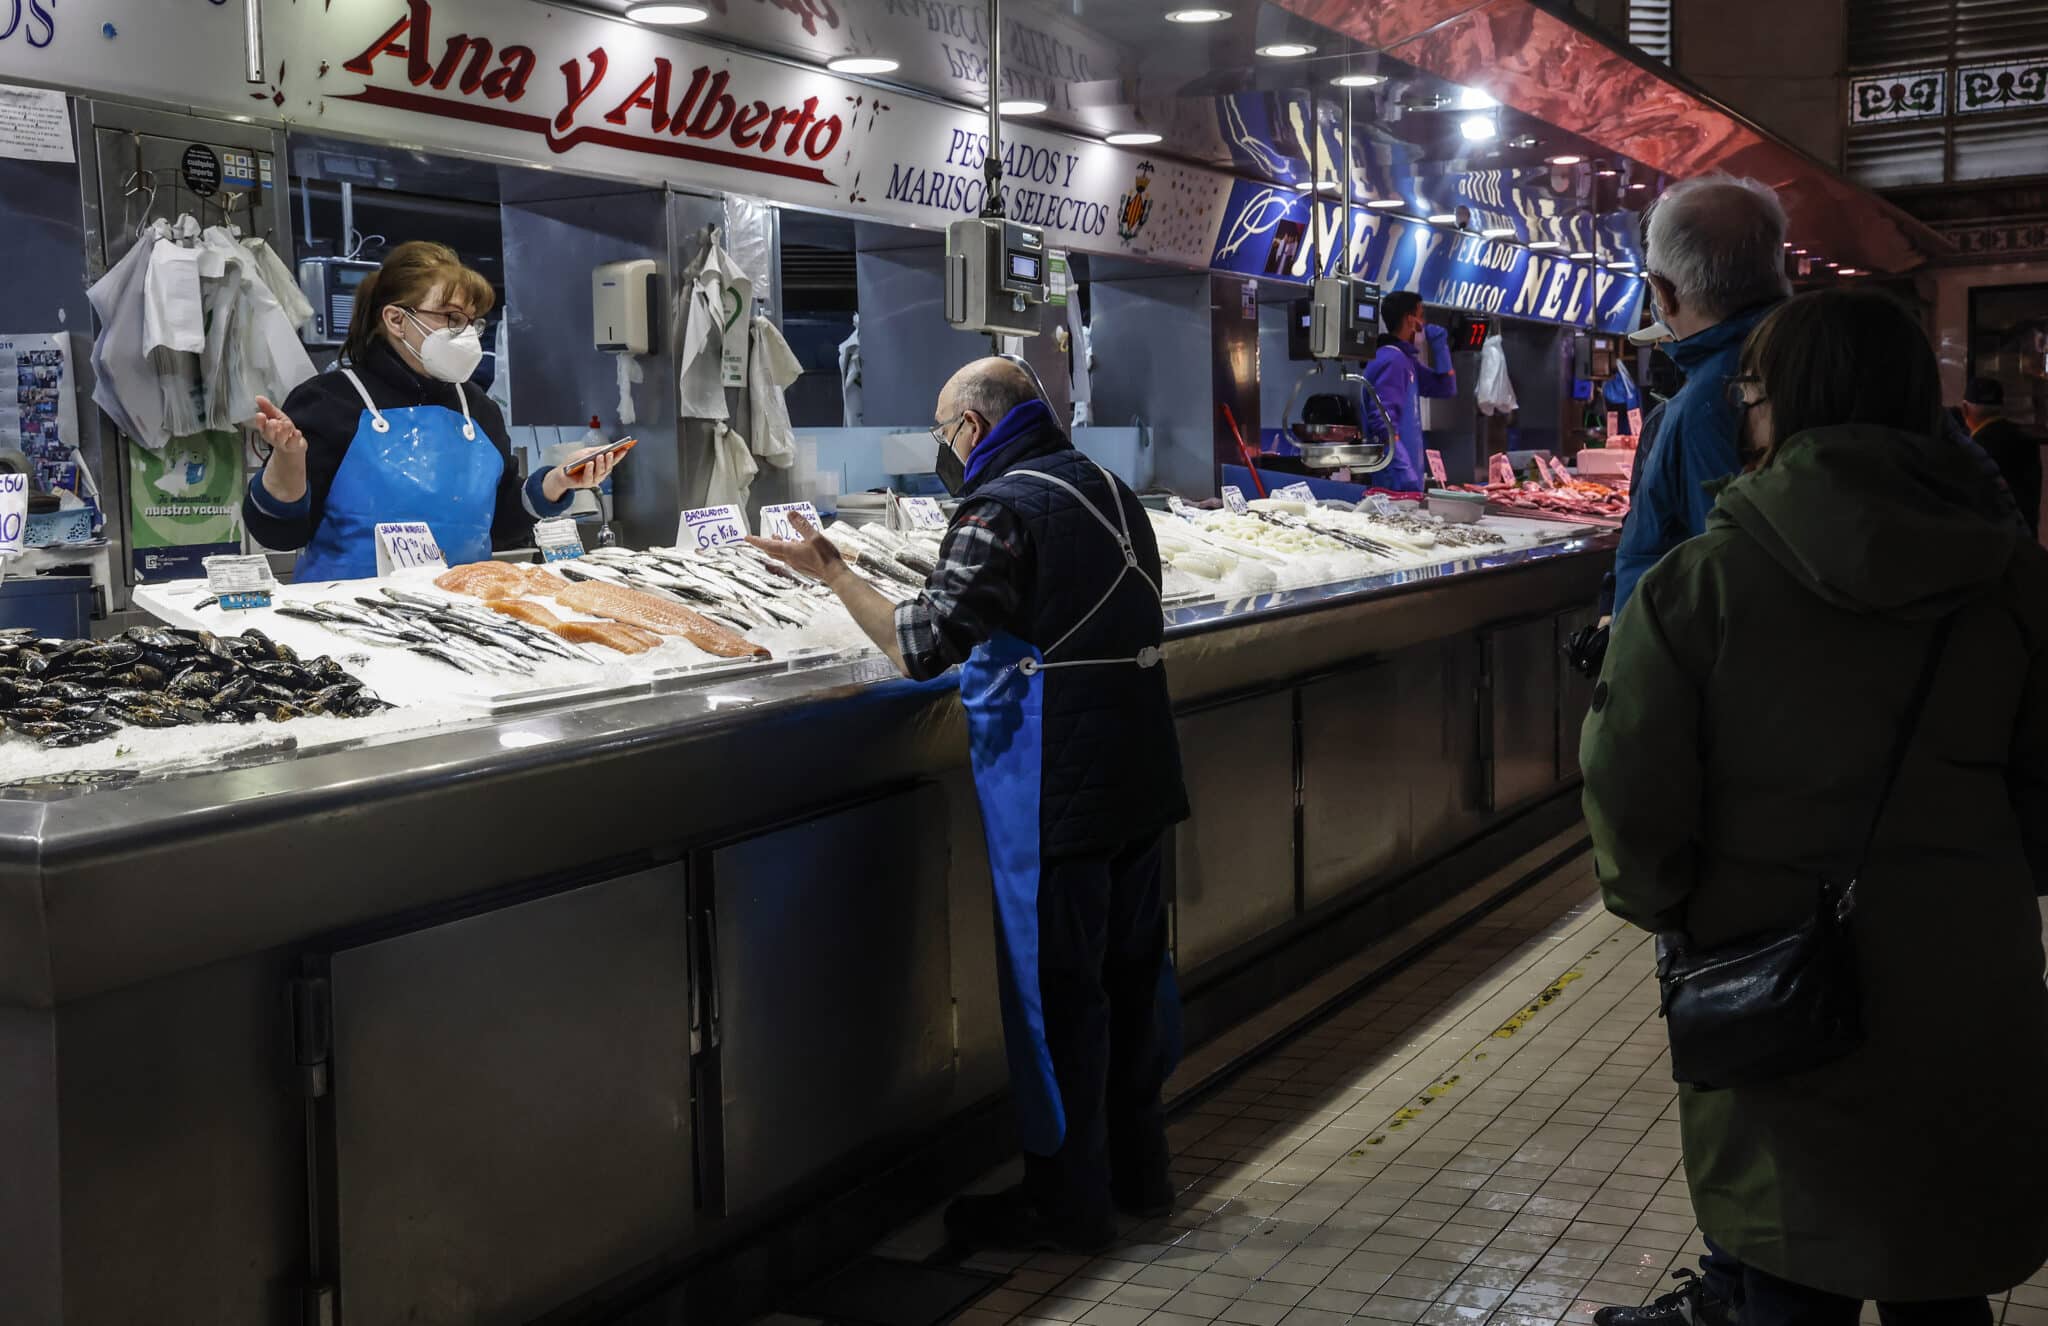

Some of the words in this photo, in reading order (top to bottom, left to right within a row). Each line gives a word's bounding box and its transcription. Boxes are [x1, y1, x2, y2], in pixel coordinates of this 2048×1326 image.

[343, 0, 536, 102] Ana
[604, 57, 842, 160] Alberto
[946, 129, 1060, 185] PESADOS
[1063, 154, 1079, 187] Y
[1011, 188, 1109, 236] SELECTOS
[1291, 202, 1442, 294] NELY
[1449, 233, 1521, 273] PESCADOS
[1513, 256, 1614, 325] NELY
[1470, 324, 1484, 345] 77
[145, 504, 191, 516] nuestra
